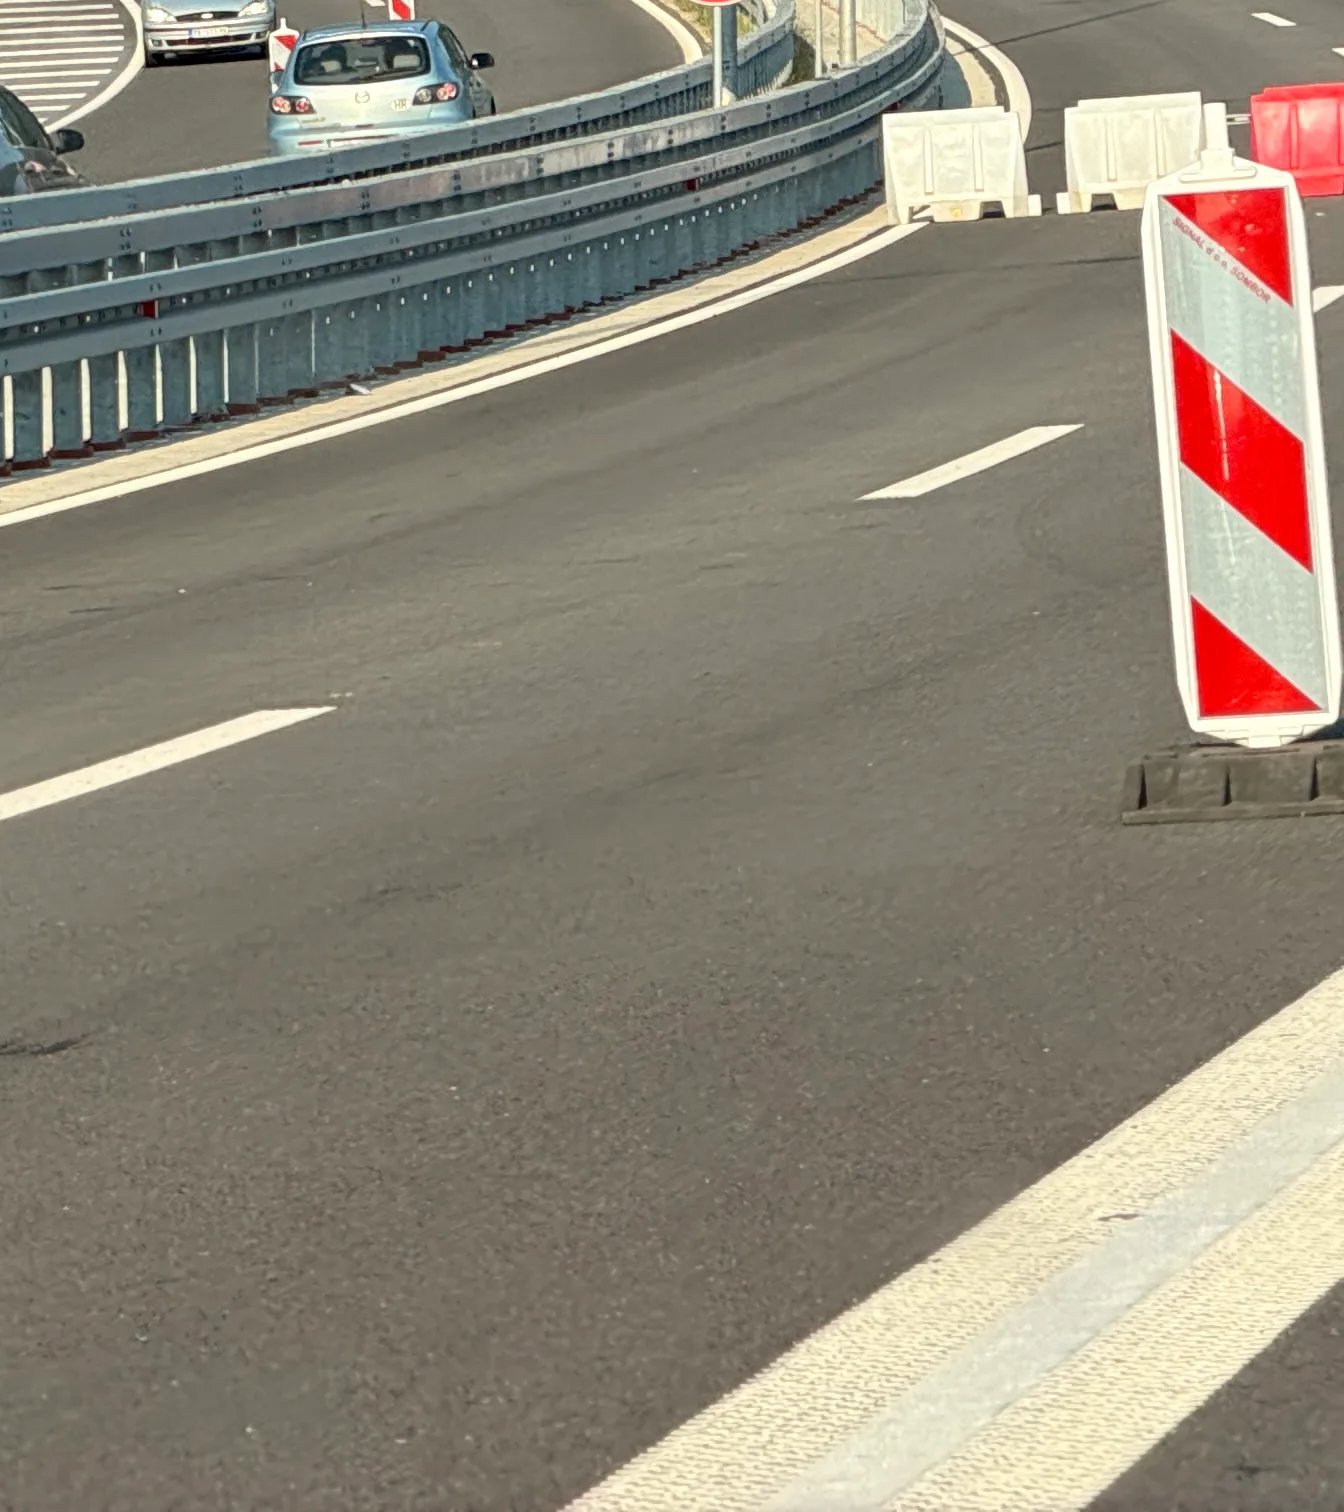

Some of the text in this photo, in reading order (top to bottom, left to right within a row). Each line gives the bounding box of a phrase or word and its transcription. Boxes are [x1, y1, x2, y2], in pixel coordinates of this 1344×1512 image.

[394, 98, 407, 109] HR
[1173, 217, 1205, 249] SIGNAL
[1230, 266, 1271, 304] SOMBOR
